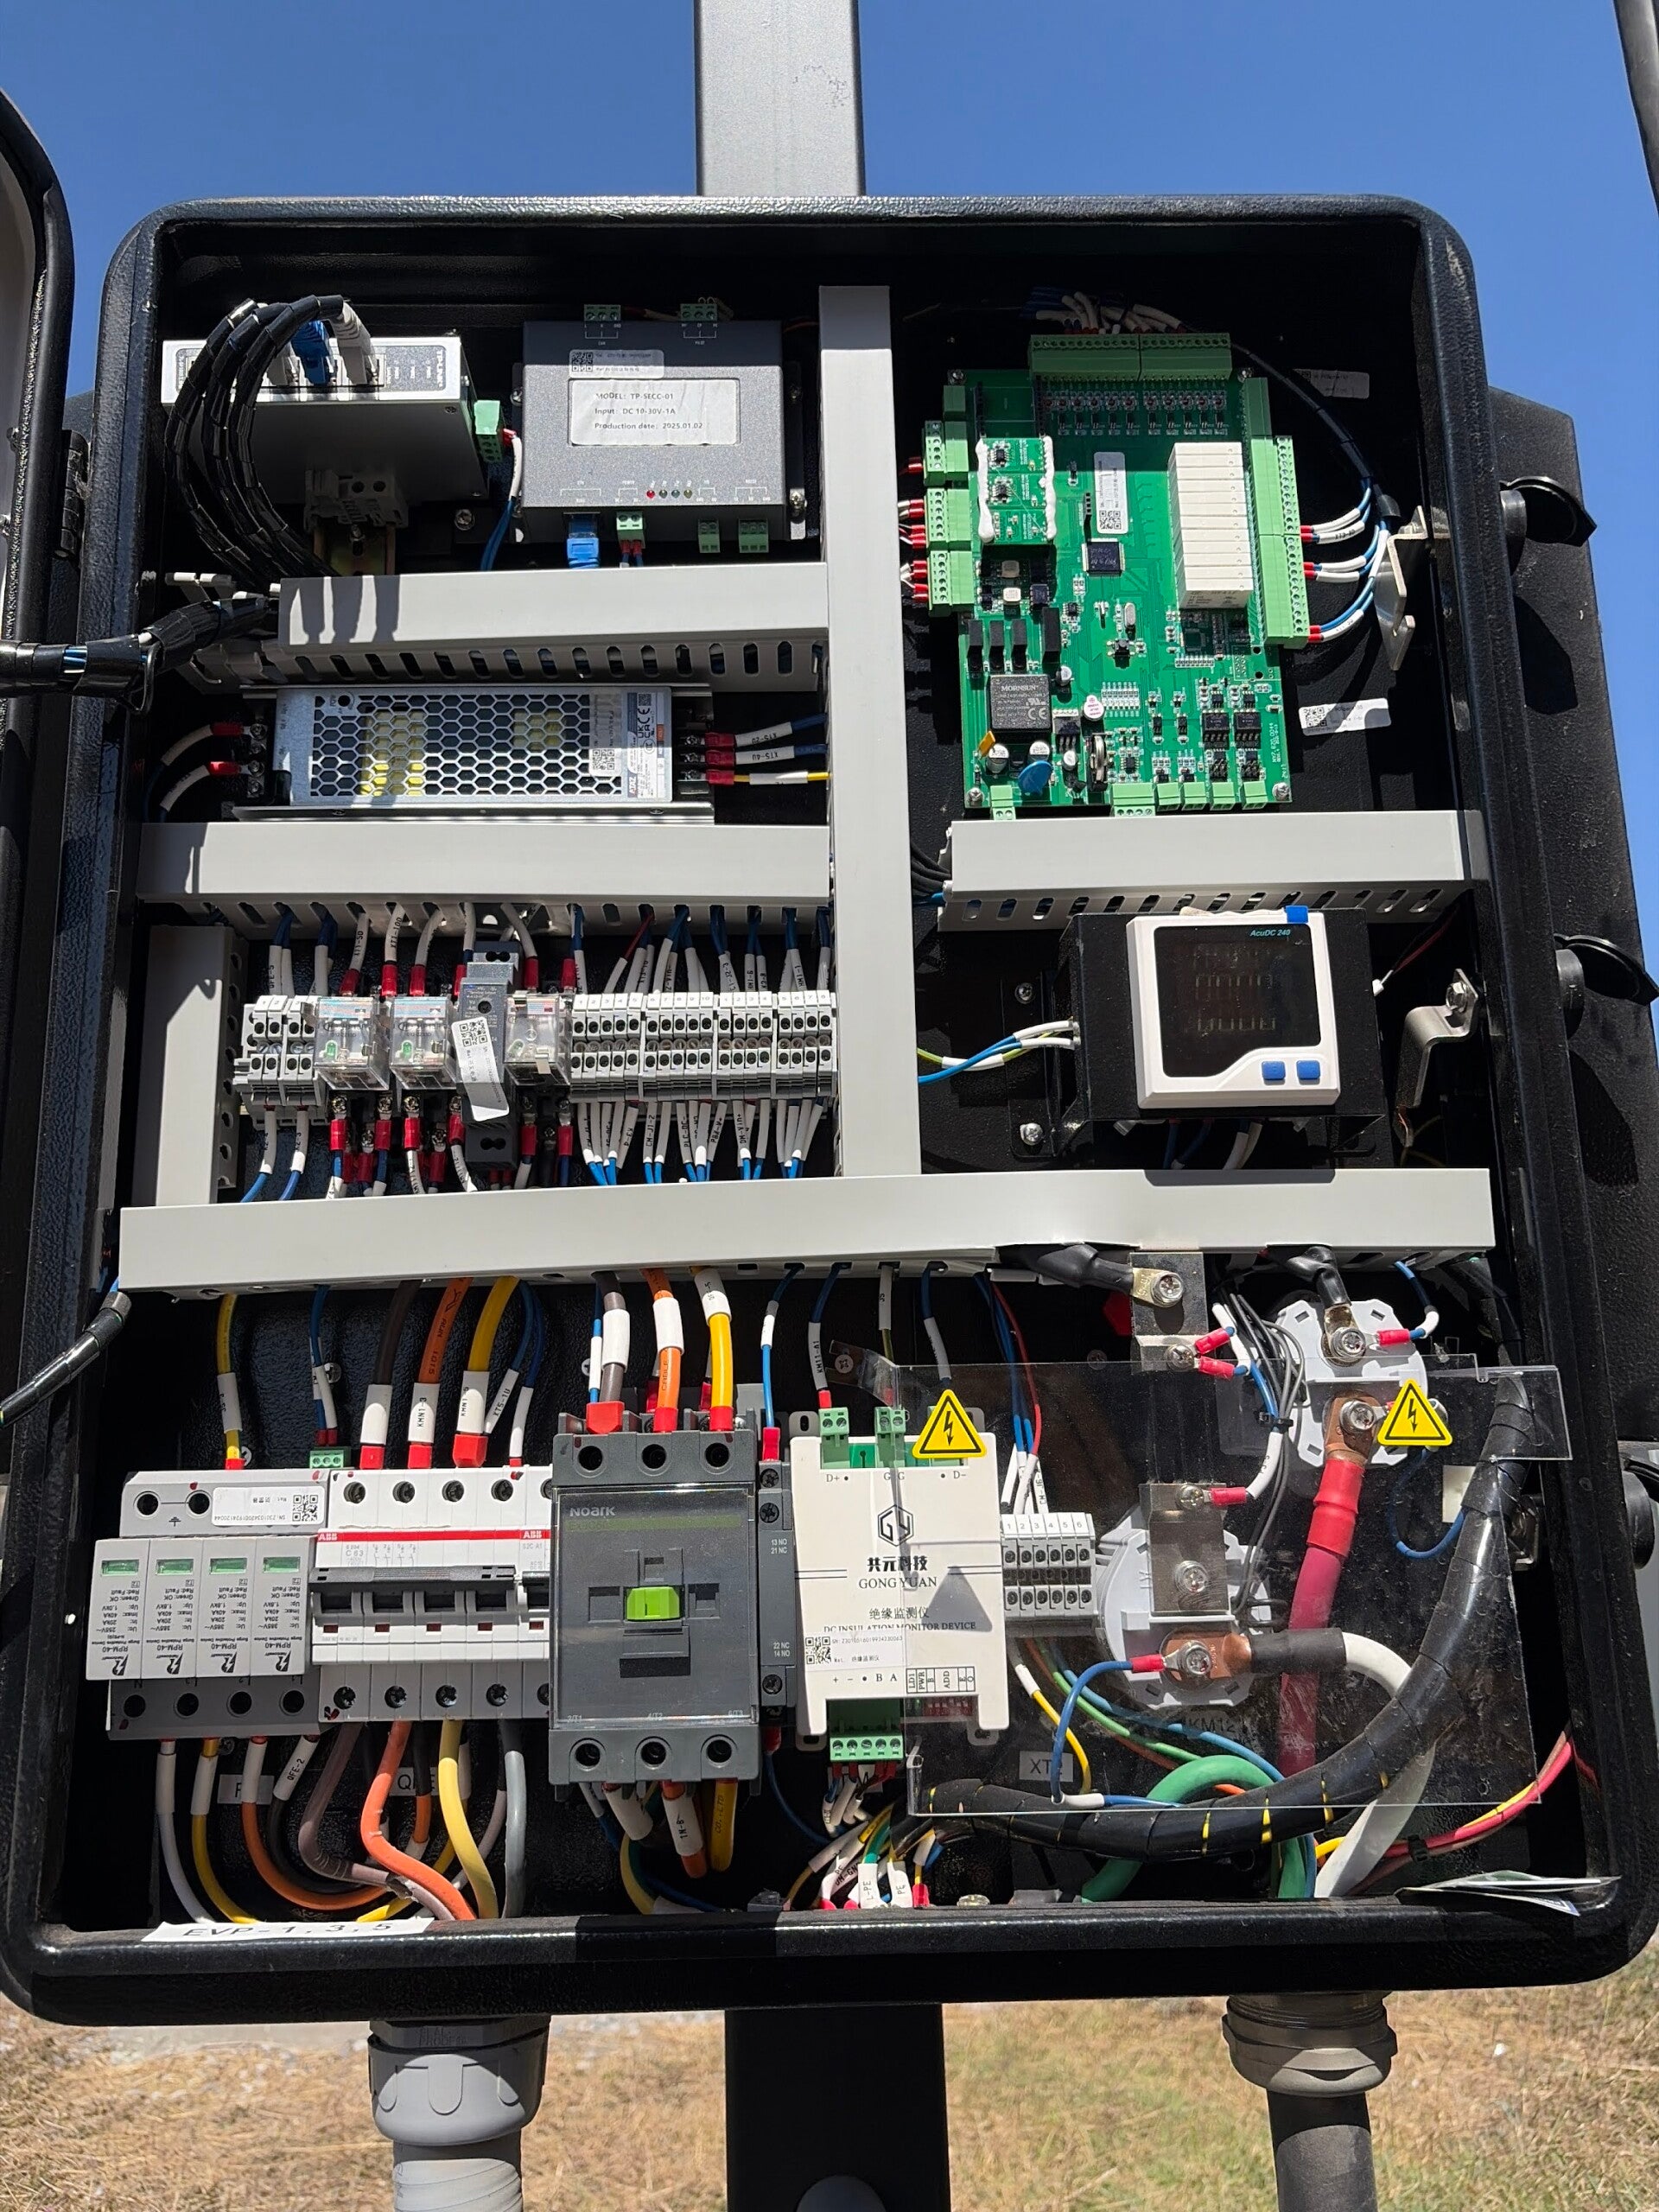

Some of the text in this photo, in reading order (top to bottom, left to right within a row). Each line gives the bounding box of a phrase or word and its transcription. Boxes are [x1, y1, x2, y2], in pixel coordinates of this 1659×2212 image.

[1249, 928, 1291, 938] AcuDC 240
[867, 1555, 928, 1572] 共元科技
[858, 1575, 938, 1589] GONG YUAN
[868, 1606, 930, 1620] 绝缘监测仪
[899, 1622, 938, 1632] MONITOR
[939, 1621, 976, 1630] DEVICE
[889, 1673, 898, 1681] A
[287, 1758, 305, 1782] QFE-2
